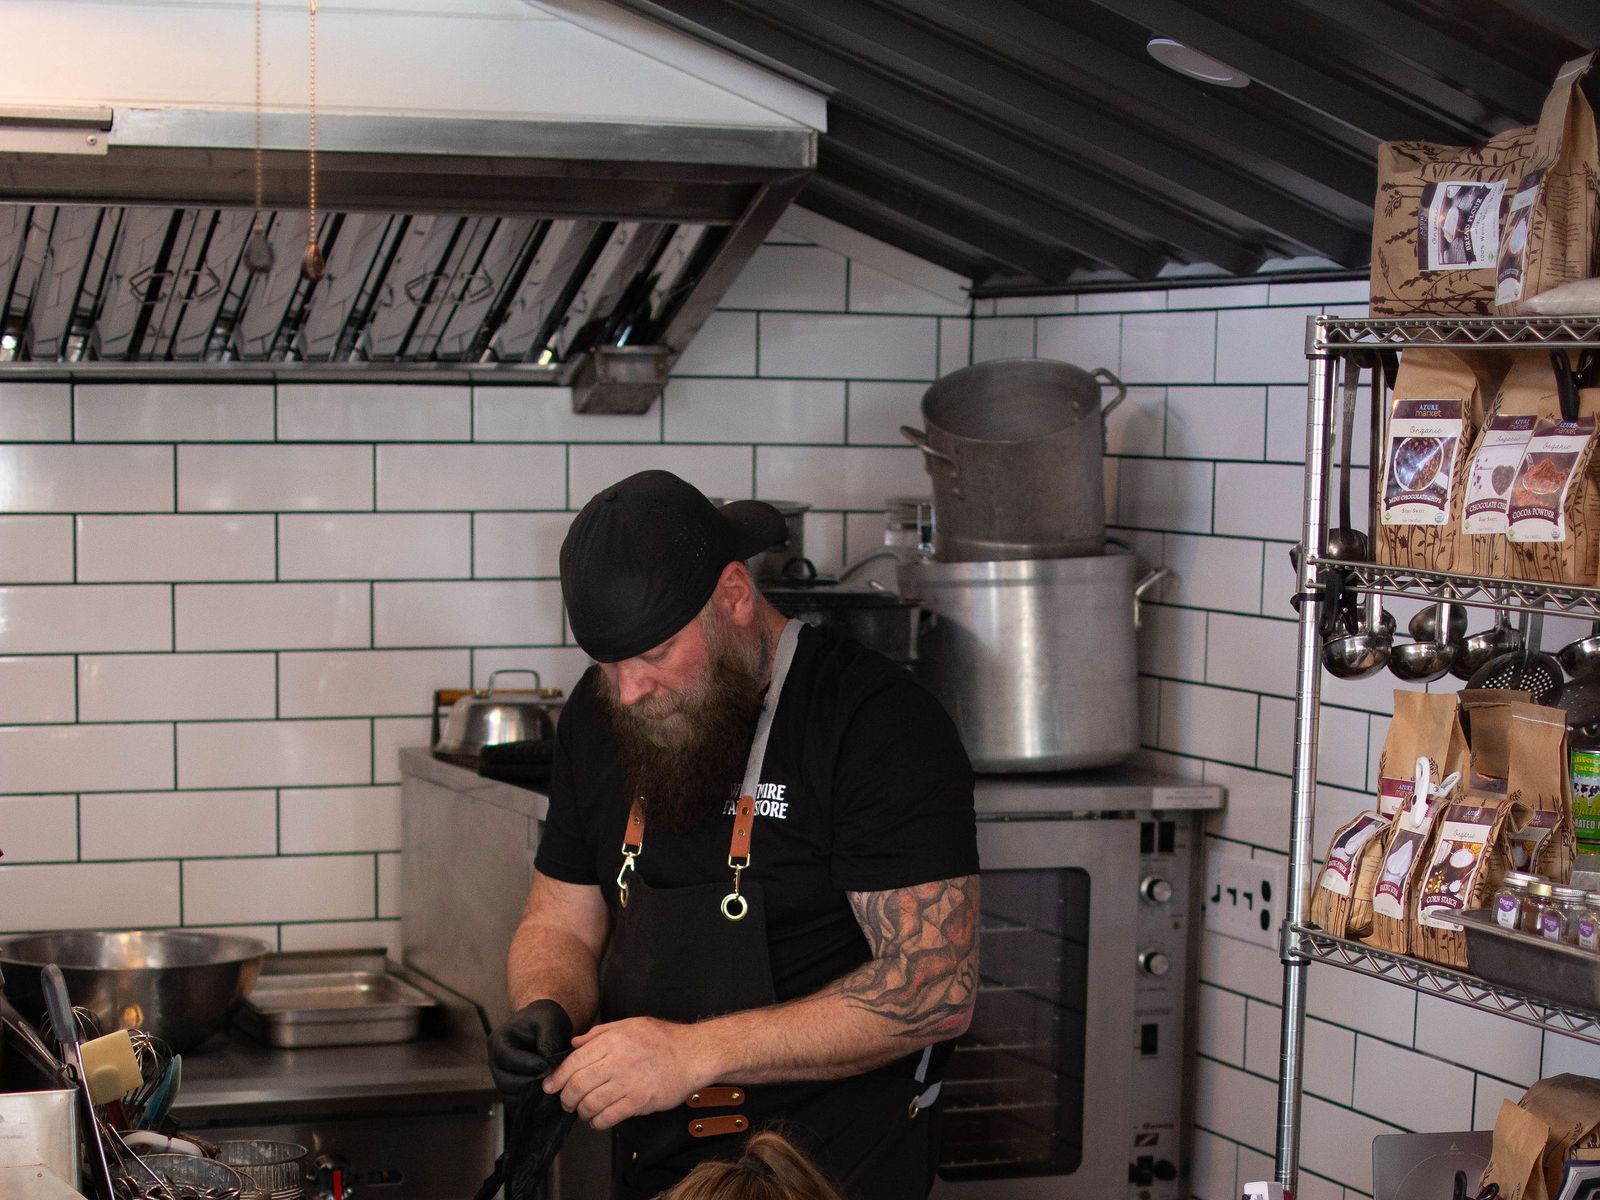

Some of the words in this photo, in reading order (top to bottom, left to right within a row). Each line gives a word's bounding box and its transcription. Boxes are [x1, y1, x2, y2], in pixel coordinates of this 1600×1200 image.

[1467, 198, 1483, 223] FLOUR
[1463, 224, 1472, 252] BREAD
[1409, 426, 1442, 436] Organic
[1469, 501, 1497, 512] CHOCOLATE
[1512, 508, 1532, 519] COCOA
[1532, 507, 1555, 518] POWDER
[1572, 818, 1596, 830] RATED
[1426, 895, 1441, 903] CORN
[1440, 895, 1458, 907] STARCH
